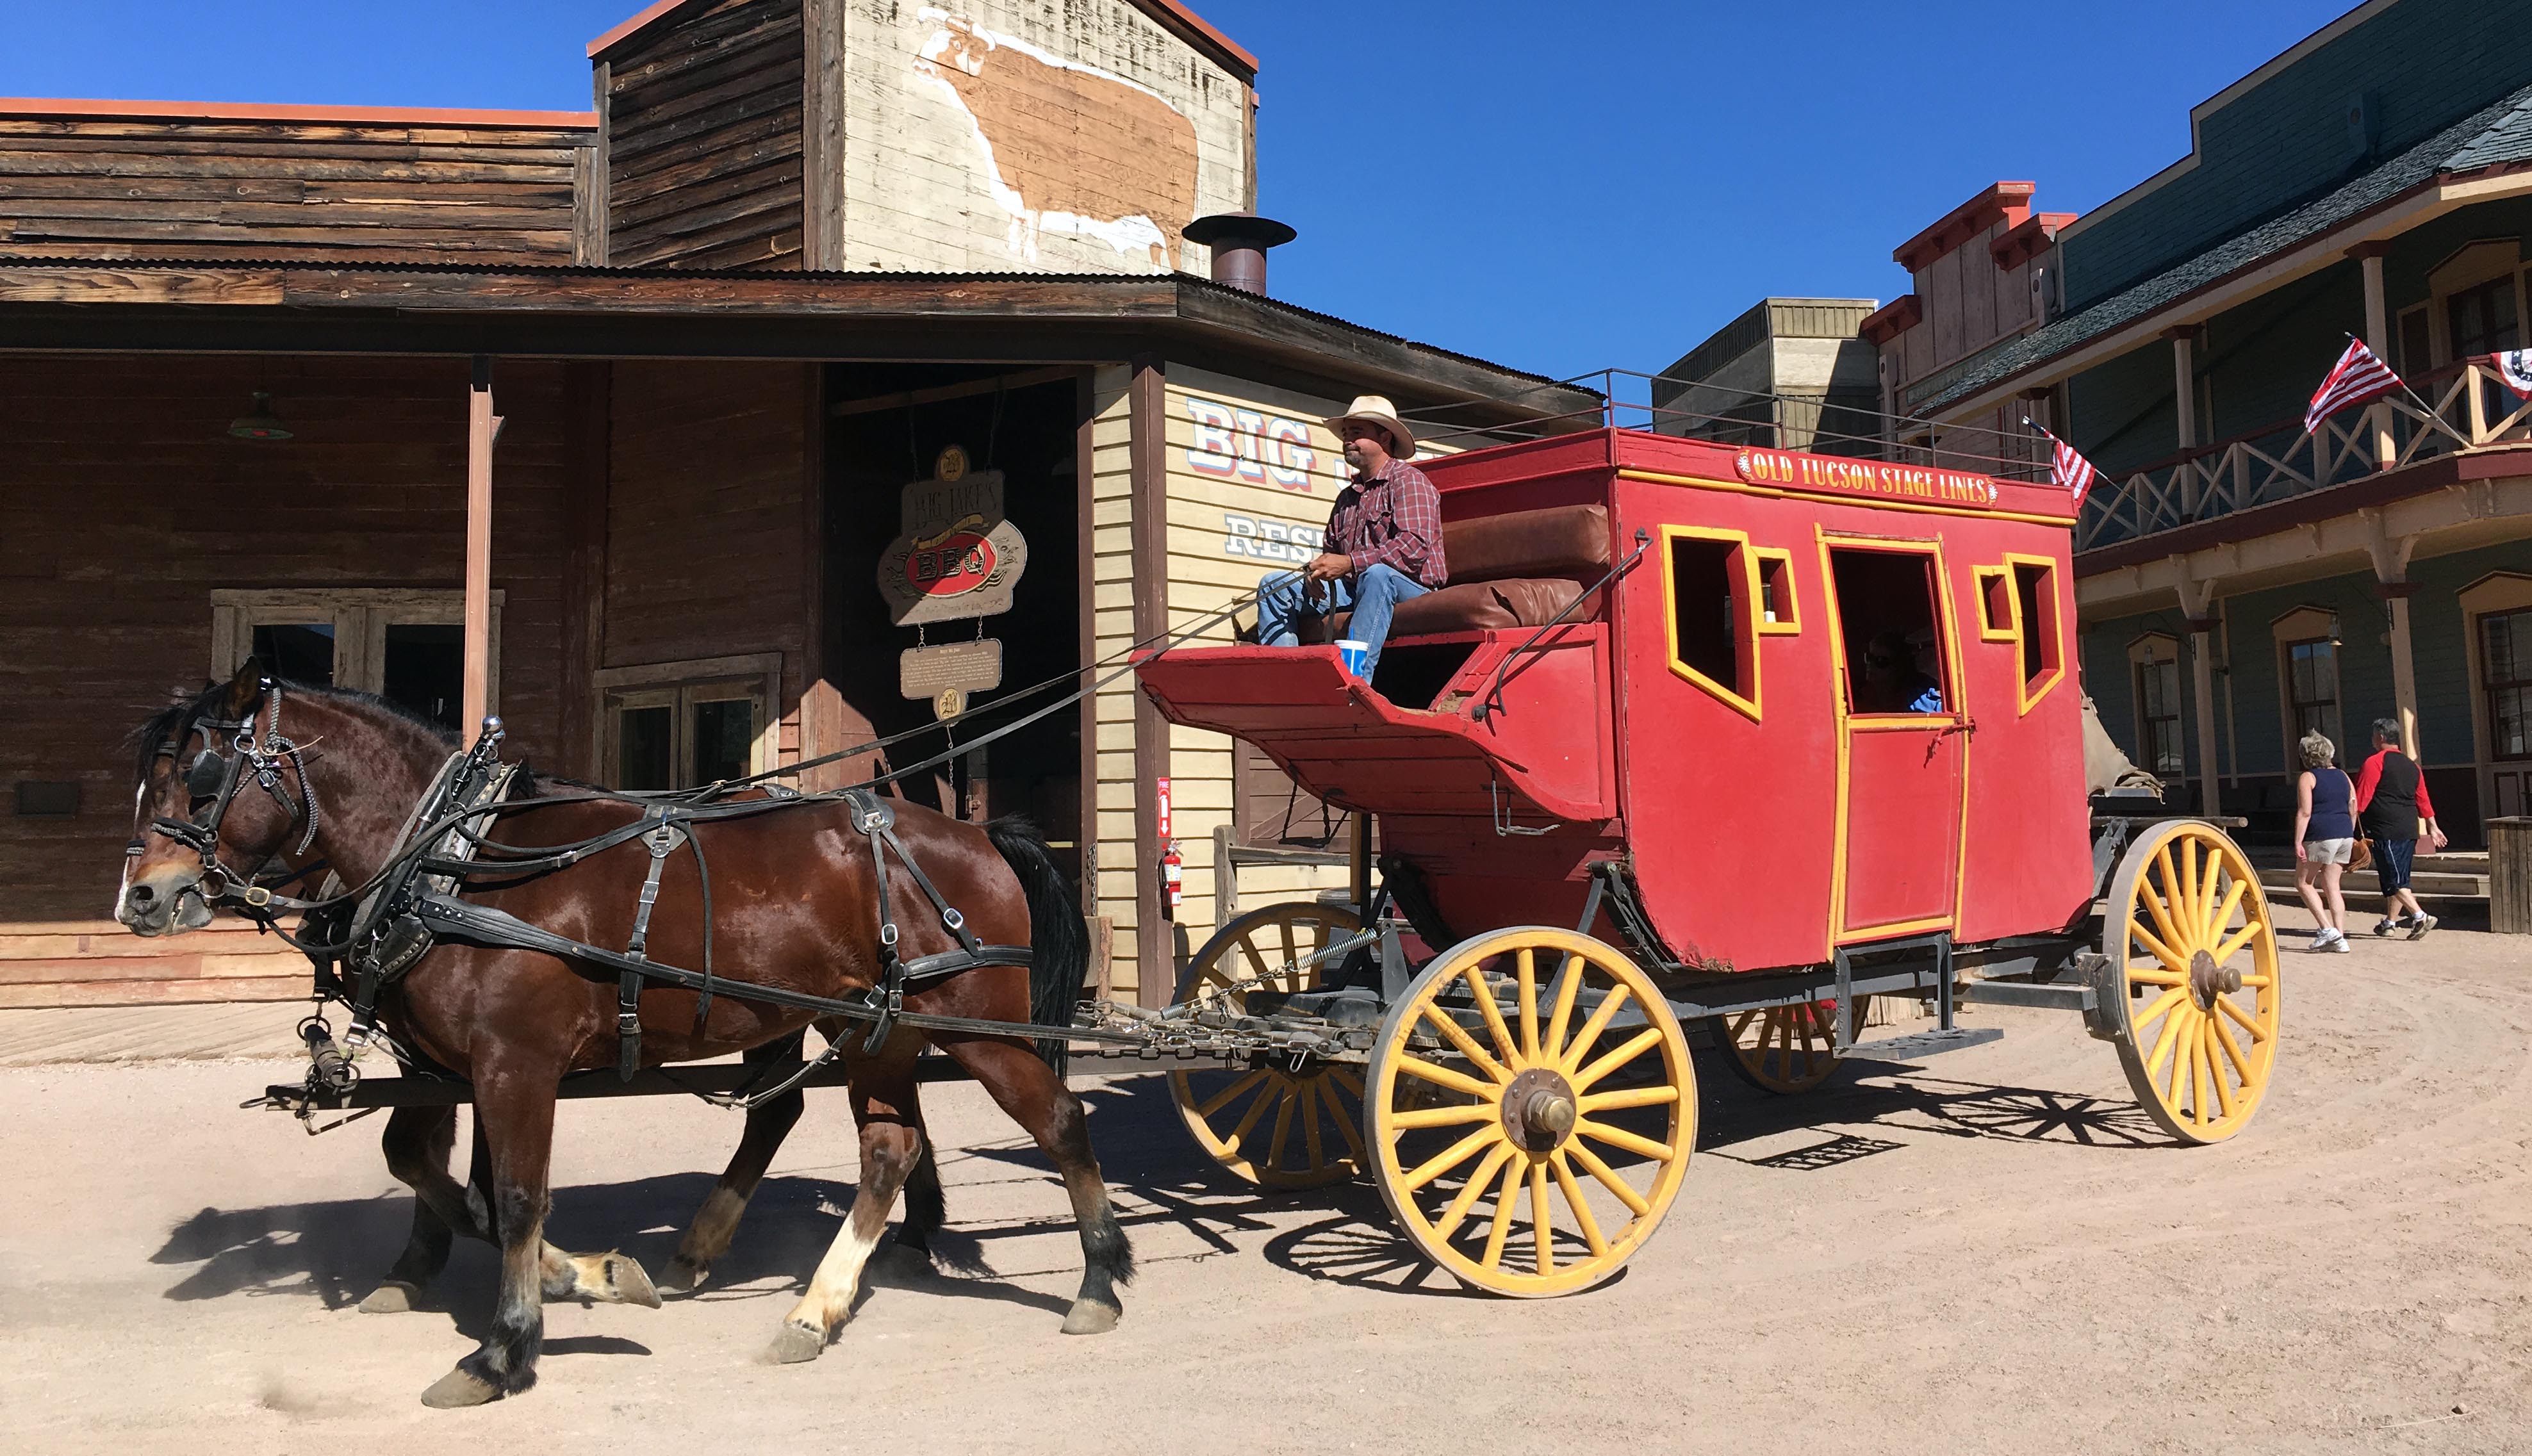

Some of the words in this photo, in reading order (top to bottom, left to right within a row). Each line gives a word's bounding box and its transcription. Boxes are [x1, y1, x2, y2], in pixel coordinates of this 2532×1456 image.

[1187, 397, 1317, 493] BIG
[1753, 453, 1795, 483] OLD
[1798, 457, 1877, 492] TUCSON
[1881, 468, 1936, 498] STAGE
[1939, 475, 1987, 503] LINES
[913, 491, 942, 530] BIG
[916, 543, 986, 582] BBQ
